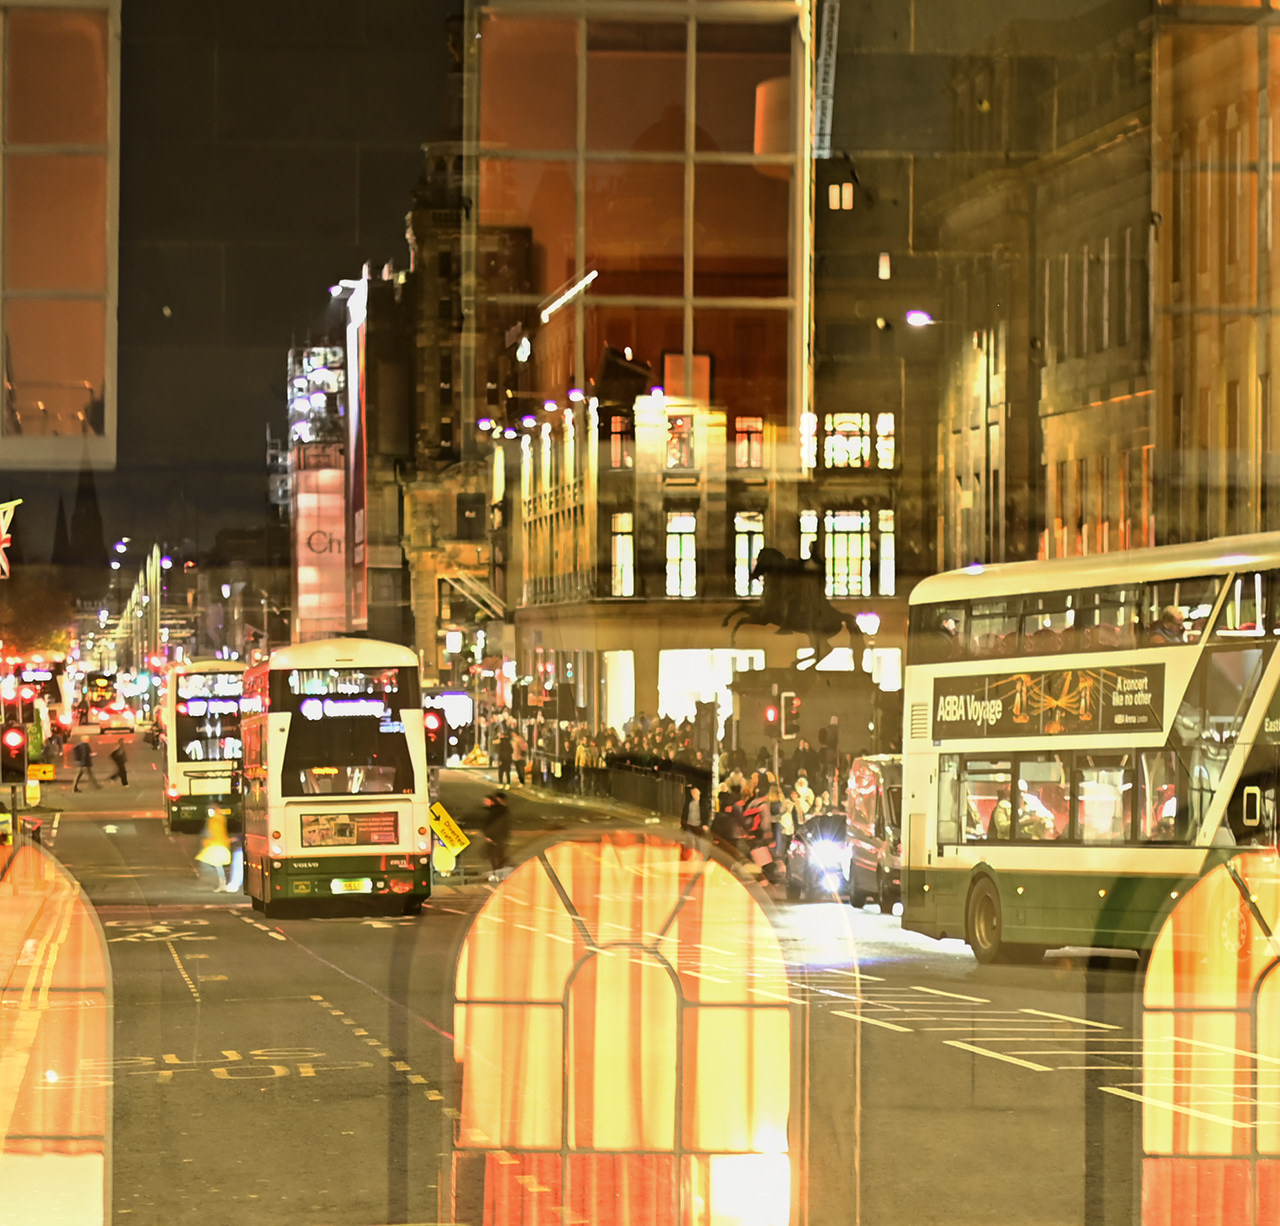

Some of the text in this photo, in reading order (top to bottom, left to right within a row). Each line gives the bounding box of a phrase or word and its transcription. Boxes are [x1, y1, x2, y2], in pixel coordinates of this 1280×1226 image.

[1123, 676, 1149, 692] concert
[936, 695, 1003, 726] ABBA Voyage
[443, 820, 466, 847] Diverted
